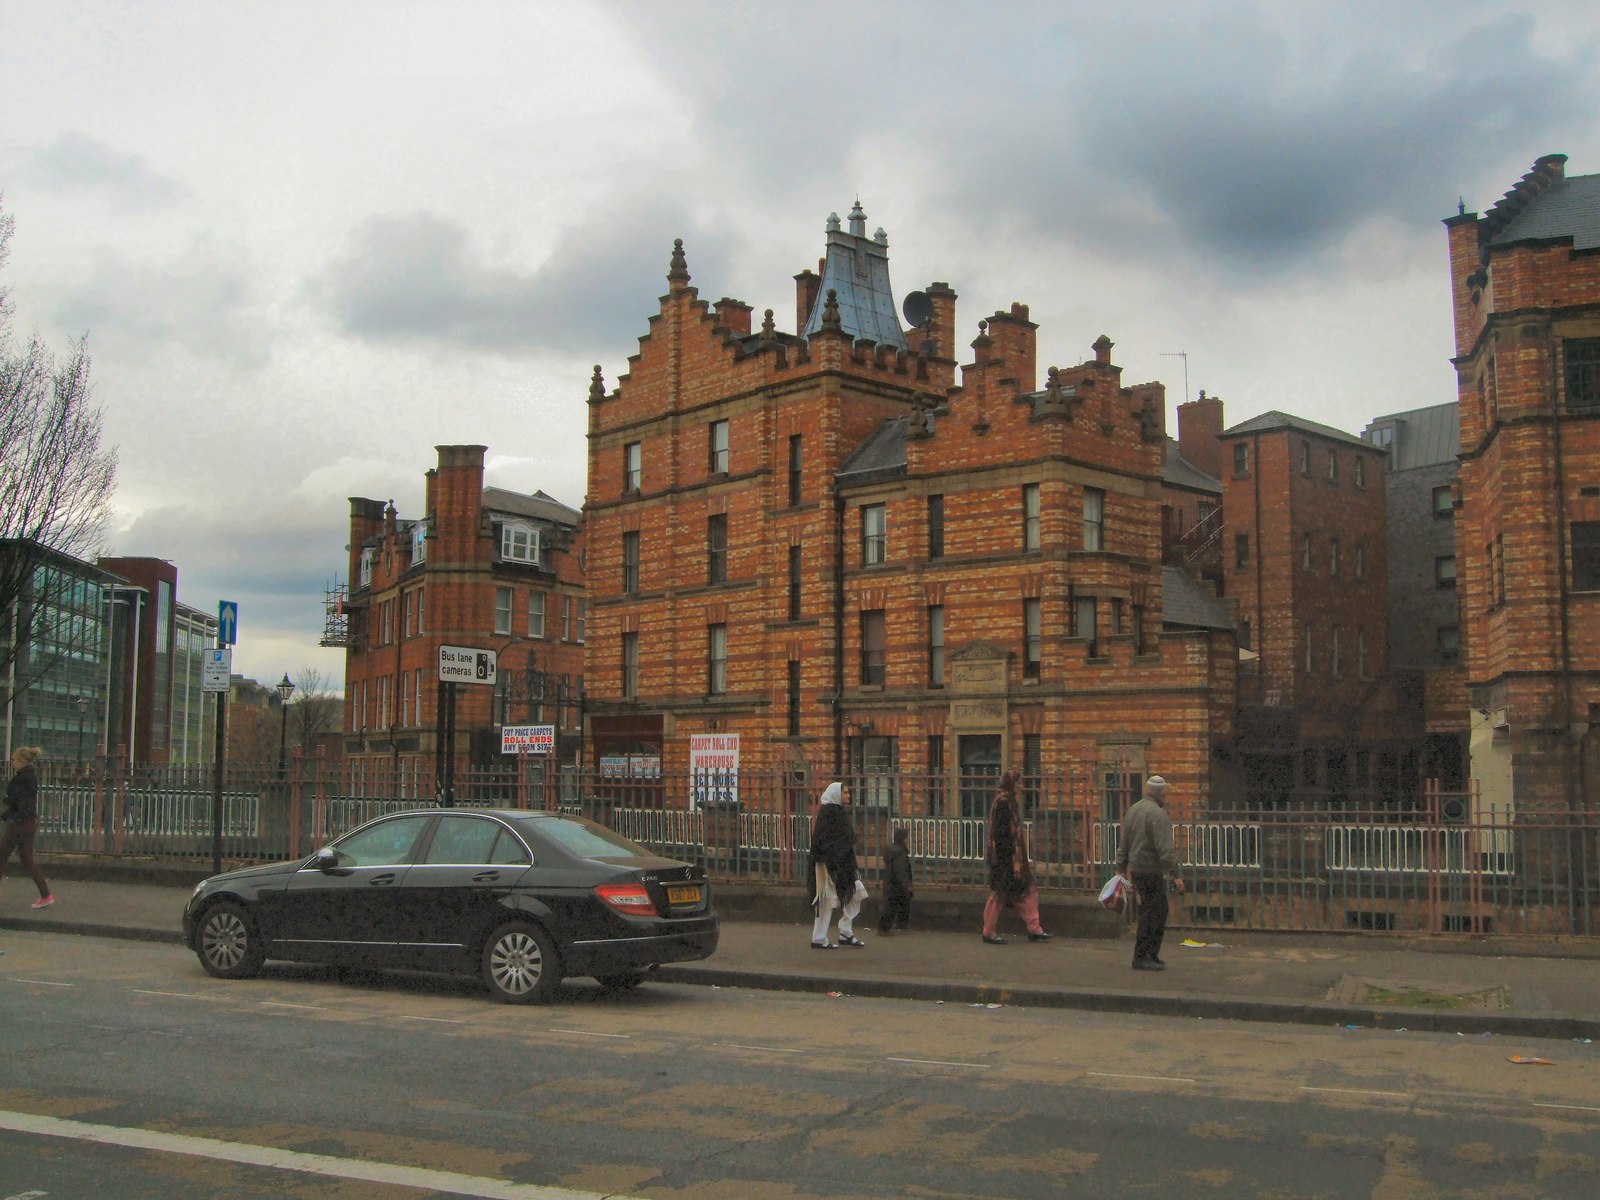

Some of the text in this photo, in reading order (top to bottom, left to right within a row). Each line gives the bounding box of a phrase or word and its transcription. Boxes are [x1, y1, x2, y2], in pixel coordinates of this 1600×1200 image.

[441, 650, 473, 663] Bus lane
[441, 666, 472, 676] cameras
[515, 728, 529, 736] PRICE
[530, 728, 552, 736] CARPETS
[691, 737, 738, 750] CARPET ROLL END
[695, 755, 734, 768] WAREHOUSE
